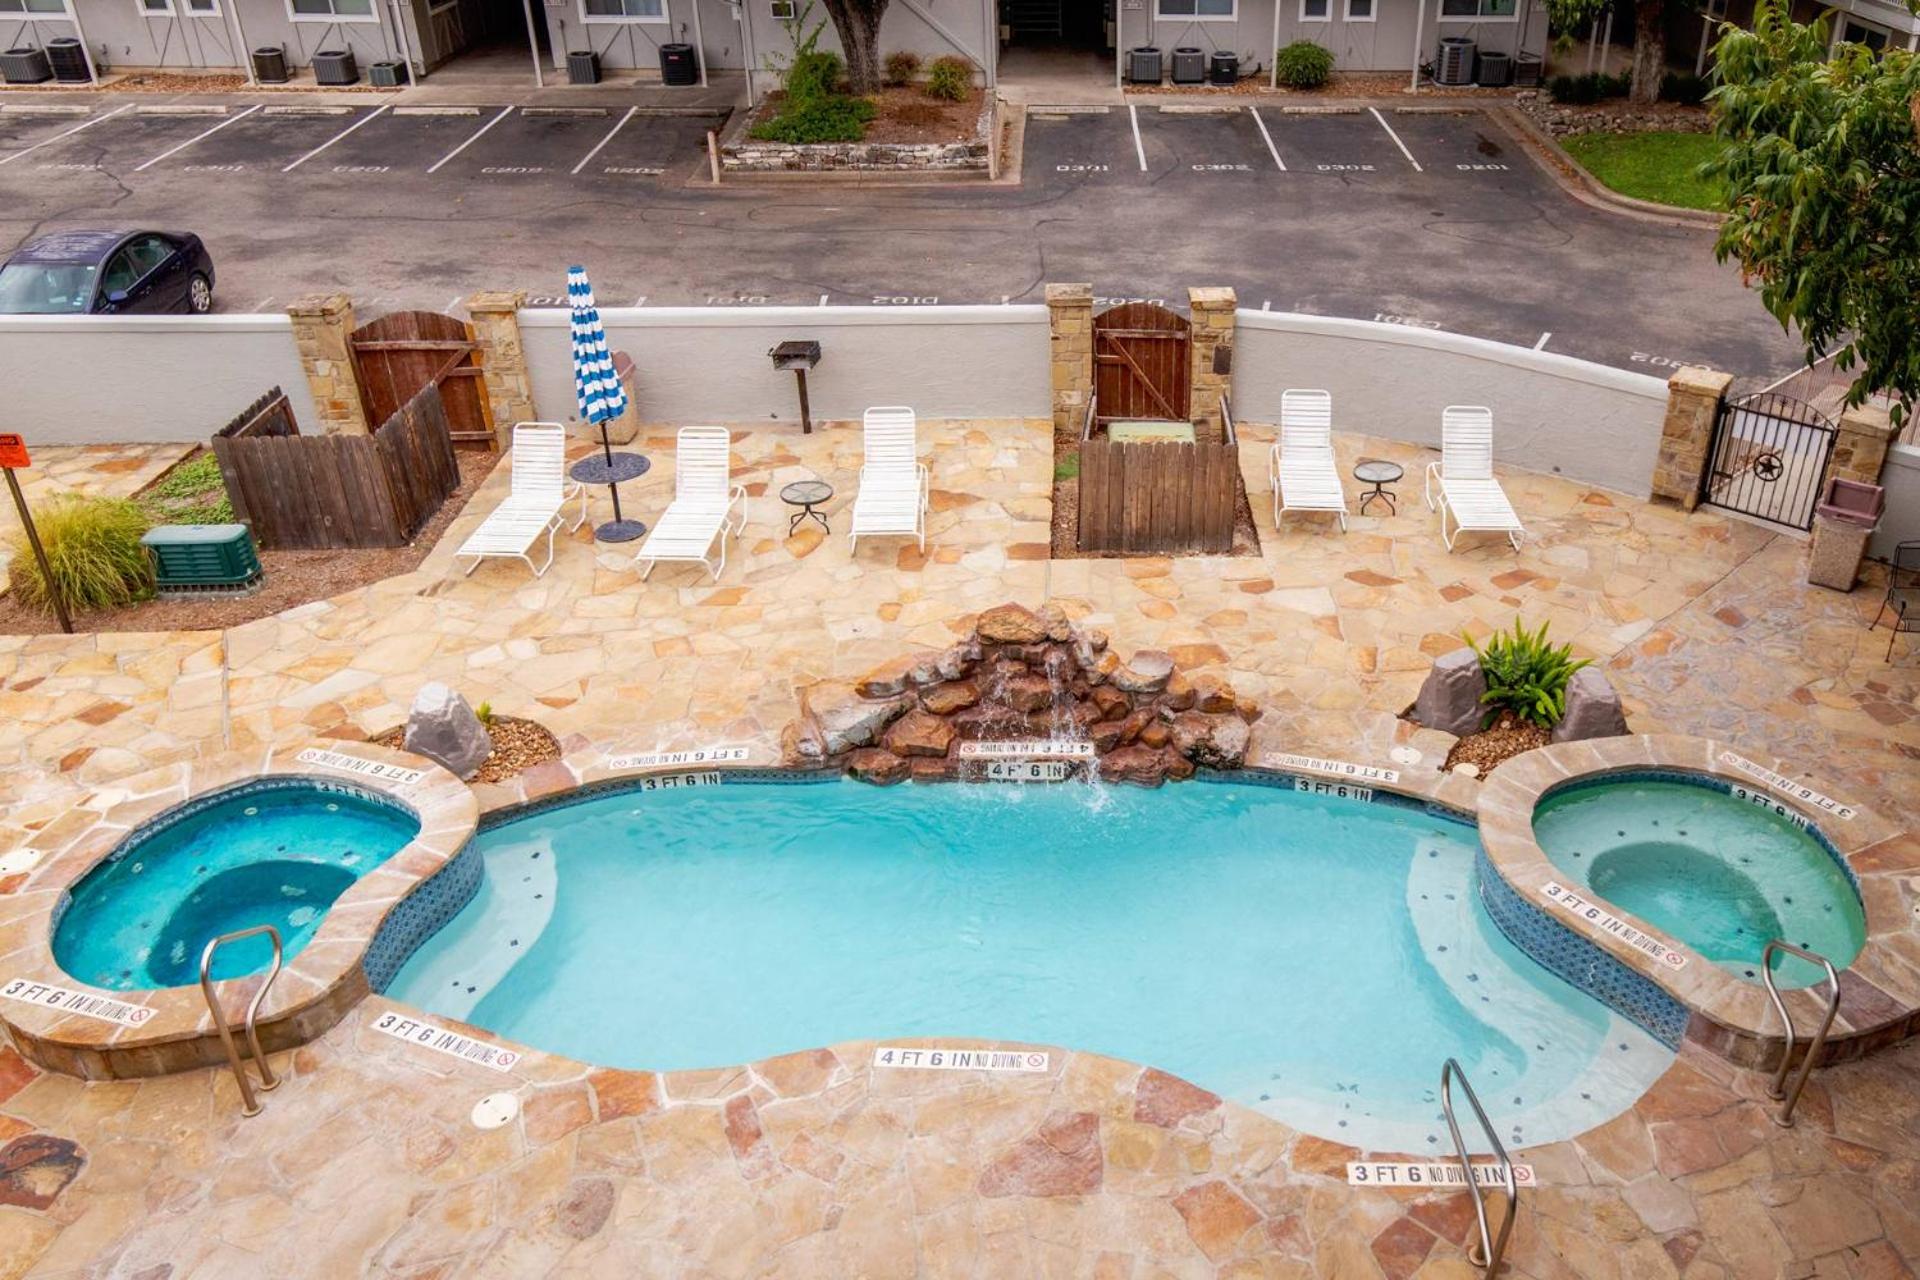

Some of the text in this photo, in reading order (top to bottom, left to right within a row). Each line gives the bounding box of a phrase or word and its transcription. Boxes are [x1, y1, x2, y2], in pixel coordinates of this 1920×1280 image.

[872, 296, 938, 304] D102
[734, 749, 744, 758] 3
[1080, 744, 1089, 753] 4
[672, 753, 687, 762] IN
[695, 752, 705, 761] 6
[712, 750, 728, 760] FT
[351, 760, 371, 771] IN
[371, 764, 385, 774] 6
[992, 764, 1003, 775] 4
[1031, 765, 1040, 777] 6
[1047, 764, 1062, 777] IN
[1324, 761, 1339, 771] IN
[1346, 765, 1355, 774] 6
[385, 767, 406, 779] FT
[405, 772, 419, 782] 3
[1363, 767, 1378, 778] FT
[1384, 771, 1393, 780] 3
[646, 773, 718, 790] 3 FT 6 IN
[1777, 779, 1797, 792] IN
[320, 781, 385, 807] 3 FT 6 IN
[1300, 780, 1369, 802] 3 FT 6 IN
[1798, 789, 1812, 799] 6
[1737, 788, 1806, 829] 3 FT 6 IN
[1814, 797, 1836, 810] FT
[1838, 808, 1852, 818] 3
[1547, 886, 1666, 957] 3 FT 6 IN NO DIVING
[6, 982, 132, 1020] 3 FT 6 IN NO DIVING
[379, 1015, 498, 1063] 3 FT 6 IN NO DIVING
[881, 1050, 1023, 1069] 4 FT 6 IN NO DIVING
[1355, 1165, 1368, 1182] 3
[1376, 1165, 1398, 1183] FT
[1408, 1166, 1422, 1183] 6
[1429, 1167, 1443, 1183] NO
[1485, 1166, 1505, 1183] IN
